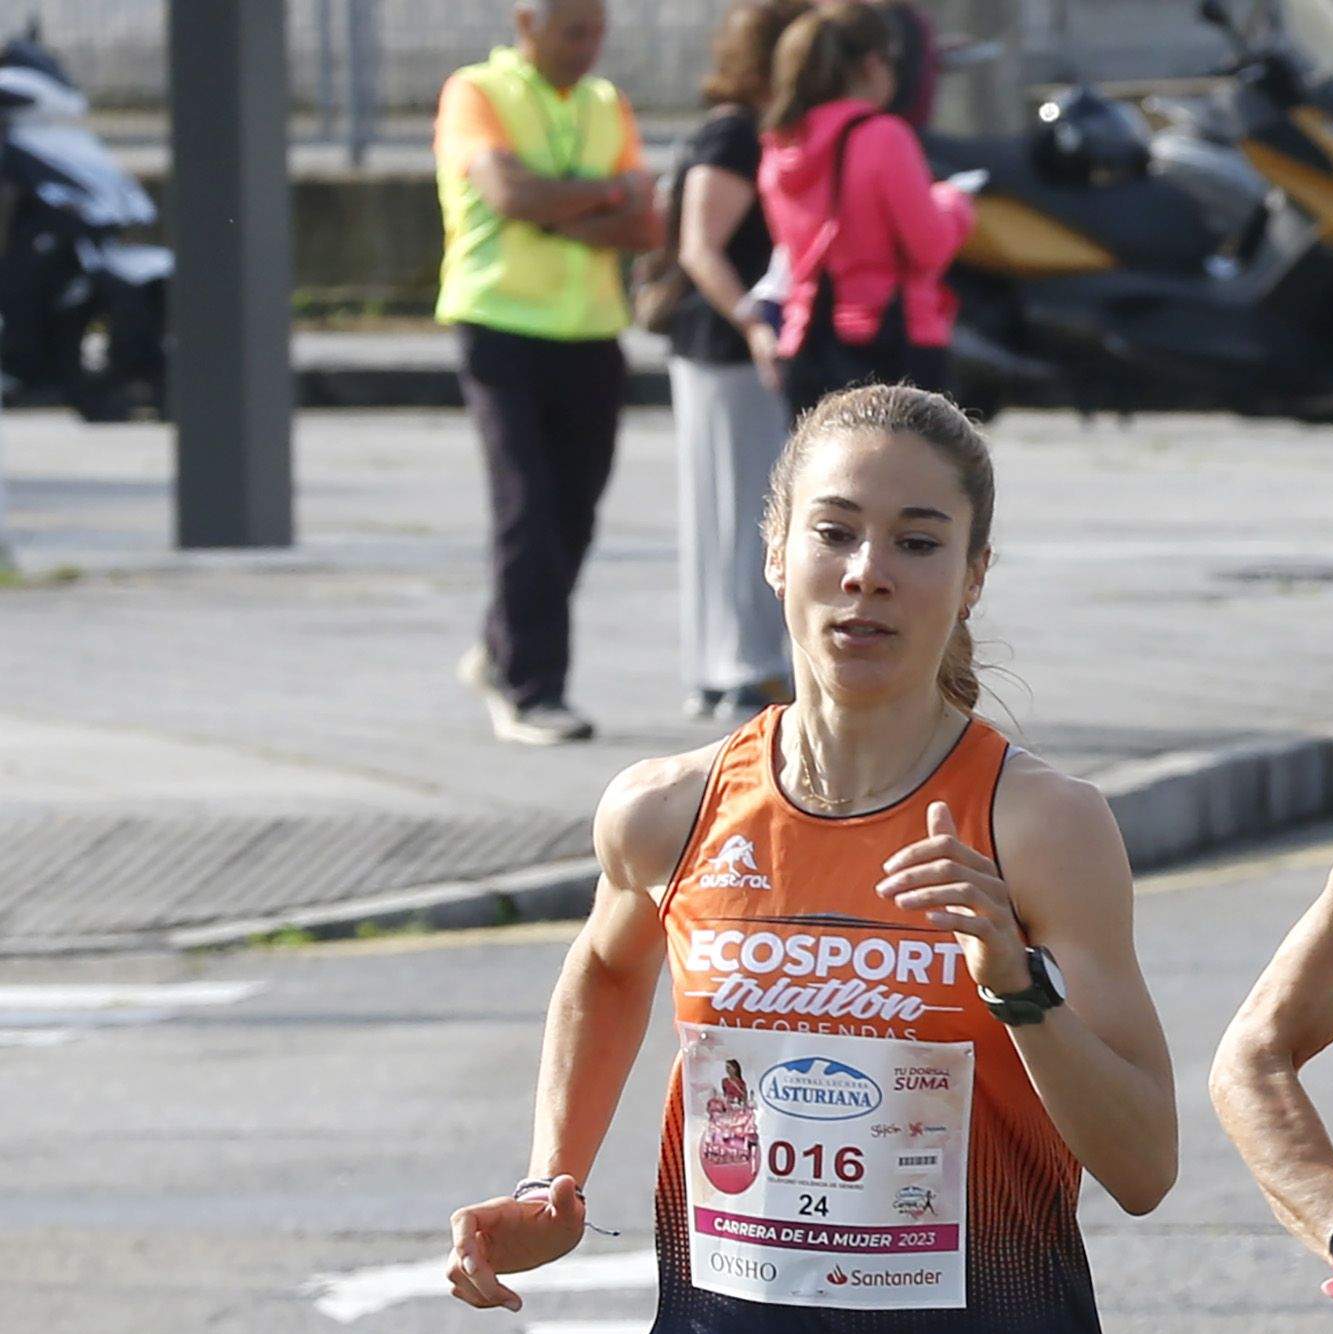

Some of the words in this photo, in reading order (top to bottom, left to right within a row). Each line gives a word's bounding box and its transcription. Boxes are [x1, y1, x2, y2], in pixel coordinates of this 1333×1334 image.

[700, 872, 772, 890] austral
[686, 929, 967, 986] ECOSPORT
[708, 972, 928, 1023] triatlón
[765, 1076, 873, 1107] ASTURIANA
[894, 1076, 950, 1091] SUMA
[768, 1139, 865, 1183] 016
[799, 1194, 830, 1217] 24
[713, 1217, 777, 1241] CARRERA
[780, 1229, 804, 1243] DE
[807, 1231, 829, 1246] LA
[832, 1233, 893, 1248] MUJER
[898, 1231, 937, 1247] 2023
[710, 1251, 777, 1283] OYSHO
[851, 1268, 942, 1287] Santander
